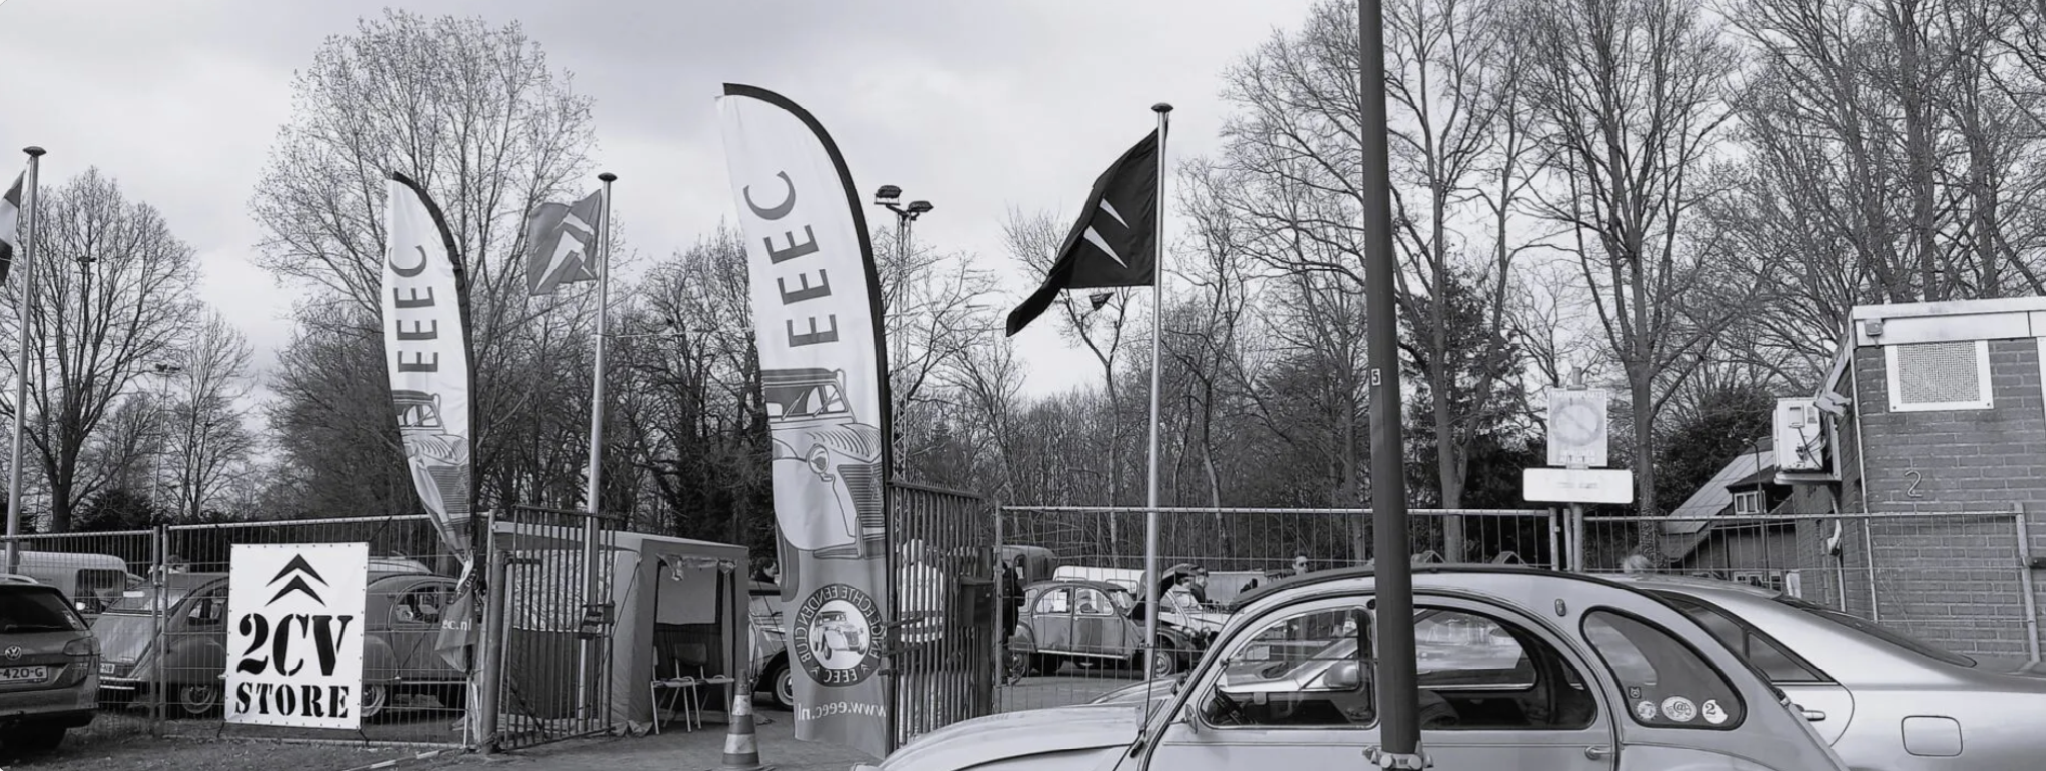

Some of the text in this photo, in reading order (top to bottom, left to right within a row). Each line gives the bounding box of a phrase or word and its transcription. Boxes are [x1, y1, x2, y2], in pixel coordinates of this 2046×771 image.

[743, 170, 839, 348] EEEC
[388, 244, 438, 373] EEEC
[1373, 370, 1379, 383] 5
[1905, 470, 1923, 497] 2
[236, 613, 353, 676] 2CV
[235, 682, 349, 718] STORE
